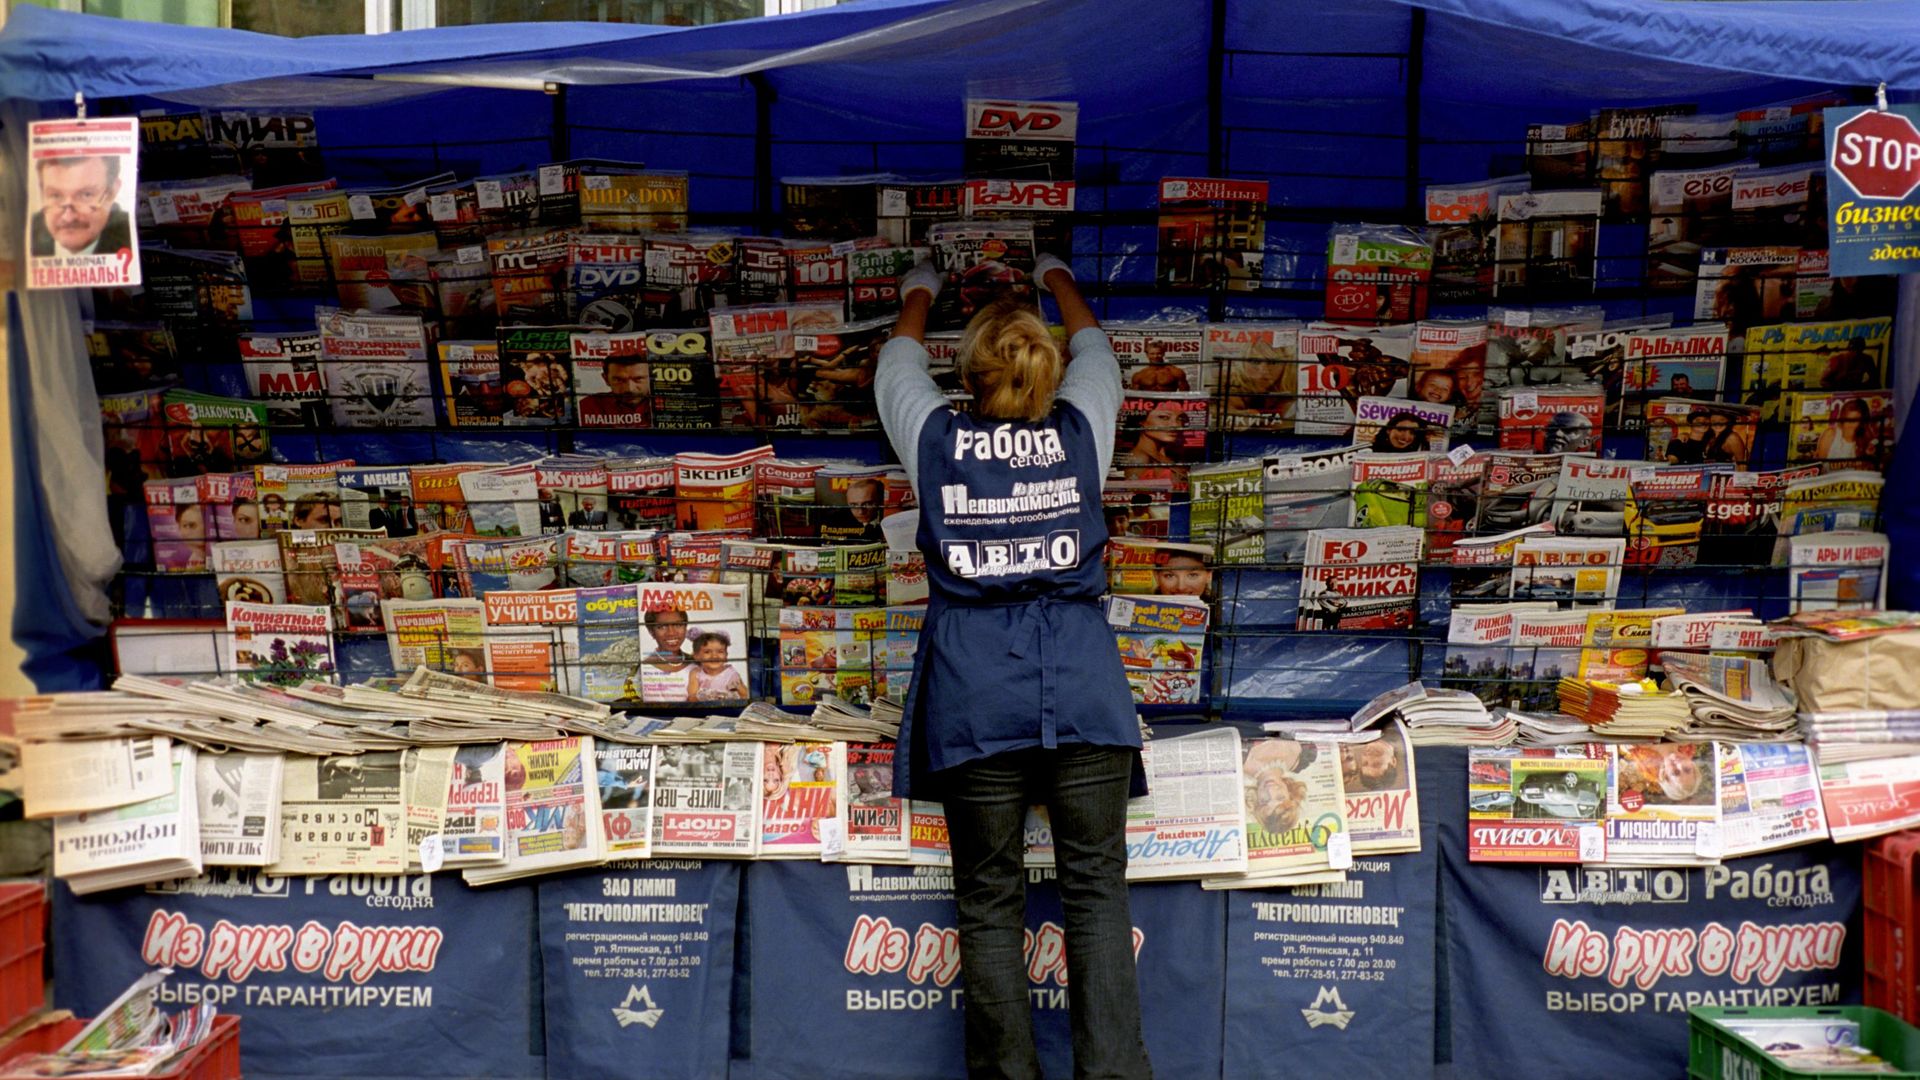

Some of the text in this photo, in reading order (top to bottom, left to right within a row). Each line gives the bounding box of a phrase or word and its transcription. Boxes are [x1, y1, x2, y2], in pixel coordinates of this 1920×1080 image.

[212, 112, 315, 142] МИР
[979, 109, 1062, 133] DVD
[1840, 132, 1920, 172] STOP
[66, 256, 107, 267] МОЛЧАТ
[1729, 254, 1796, 264] КОСМЕТИКИ
[579, 269, 642, 288] DVD
[797, 261, 844, 281] 101
[1334, 292, 1365, 305] GEO
[646, 333, 707, 355] GQ
[1420, 328, 1459, 344] HELLO!
[1629, 335, 1724, 357] РЫБАЛКА
[652, 368, 692, 382] 100
[1301, 364, 1350, 391] 10
[1304, 398, 1345, 409] ТЭФИ
[188, 403, 258, 422] ЗНАКОМСТВА
[584, 412, 643, 426] МАШКОВ
[1359, 403, 1449, 427] seventeen
[954, 423, 1065, 461] Работа
[1009, 449, 1067, 469] сегодня
[680, 464, 751, 481] ЭКСПЕР
[766, 466, 815, 479] Секрет
[1367, 464, 1424, 476] ТЮНИНГ
[363, 472, 409, 487] МЕНЕД
[611, 471, 674, 490] ПРОФИ
[208, 481, 229, 497] ТВ
[1568, 486, 1604, 499] Turbo
[941, 484, 1081, 515] Недвижимость
[944, 506, 1081, 526] еженедельник фотообъявлений
[1717, 501, 1751, 520] get
[948, 535, 1077, 576] АВТО
[1114, 550, 1171, 566] Лиза
[1323, 541, 1368, 560] F1
[1457, 546, 1495, 558] Купи
[1475, 552, 1512, 564] авто
[1521, 551, 1606, 566] АВТО
[1842, 549, 1853, 561] И
[1855, 548, 1884, 561] ЦЕНЫ
[1318, 562, 1416, 583] ВЕРНИСЬ,
[642, 588, 712, 602] МАМА
[1337, 578, 1415, 598] МИКА!
[488, 594, 546, 605] КУДА ПОЙТИ
[585, 598, 637, 613] обуче
[231, 606, 327, 625] Комнатные
[396, 614, 445, 626] НАРОДНЫЙ
[491, 602, 578, 621] УЧИТЬСЯ
[252, 620, 327, 636] растения
[1550, 635, 1583, 648] цены
[615, 758, 650, 771] МАРШ
[301, 808, 379, 828] Москва
[524, 805, 568, 831] МК
[666, 816, 733, 831] СПОРТ
[293, 826, 385, 847] Деловая
[1157, 829, 1206, 841] квартир
[1126, 828, 1240, 860] Аренда
[641, 859, 702, 871] ПРОДУКЦИЯ
[602, 878, 677, 897] ЗАО КММП
[1321, 880, 1364, 899] КММП
[1542, 863, 1831, 901] АВТО Работа
[365, 893, 435, 911] сегодня
[849, 893, 910, 902] еженедельник
[1767, 891, 1834, 909] сегодня
[565, 932, 648, 943] регистрационный
[650, 933, 679, 943] номер
[844, 914, 911, 976] Из
[1254, 931, 1404, 945] регистрационный номер 940.840
[142, 908, 444, 985] Из рук в руки
[594, 944, 683, 955] ул. Ялтинская, д. 11
[1283, 944, 1374, 957] ул. Ялтинская, д. 11
[1543, 918, 1610, 979] Из
[1608, 925, 1698, 990] рук
[1697, 921, 1736, 977] в
[1730, 920, 1847, 986] руки
[573, 957, 602, 966] время
[603, 956, 639, 967] работы
[649, 956, 667, 966] 7.00
[668, 958, 679, 967] до
[680, 956, 701, 966] 20.00
[1261, 956, 1291, 966] время
[1292, 956, 1328, 968] работы
[1337, 958, 1356, 968] 7.00
[1358, 960, 1370, 969] до
[1372, 959, 1396, 969] 20.00
[584, 969, 603, 978] тел.
[605, 968, 650, 979] 277-28-51,
[1273, 969, 1385, 981] тел. 277-28-51, 277-83-52
[150, 983, 433, 1008] ВЫБОР ГАРАНТИРУЕМ
[846, 989, 943, 1010] ВЫБОР
[1545, 983, 1840, 1014] ВЫБОР ГАРАНТИРУЕМ
